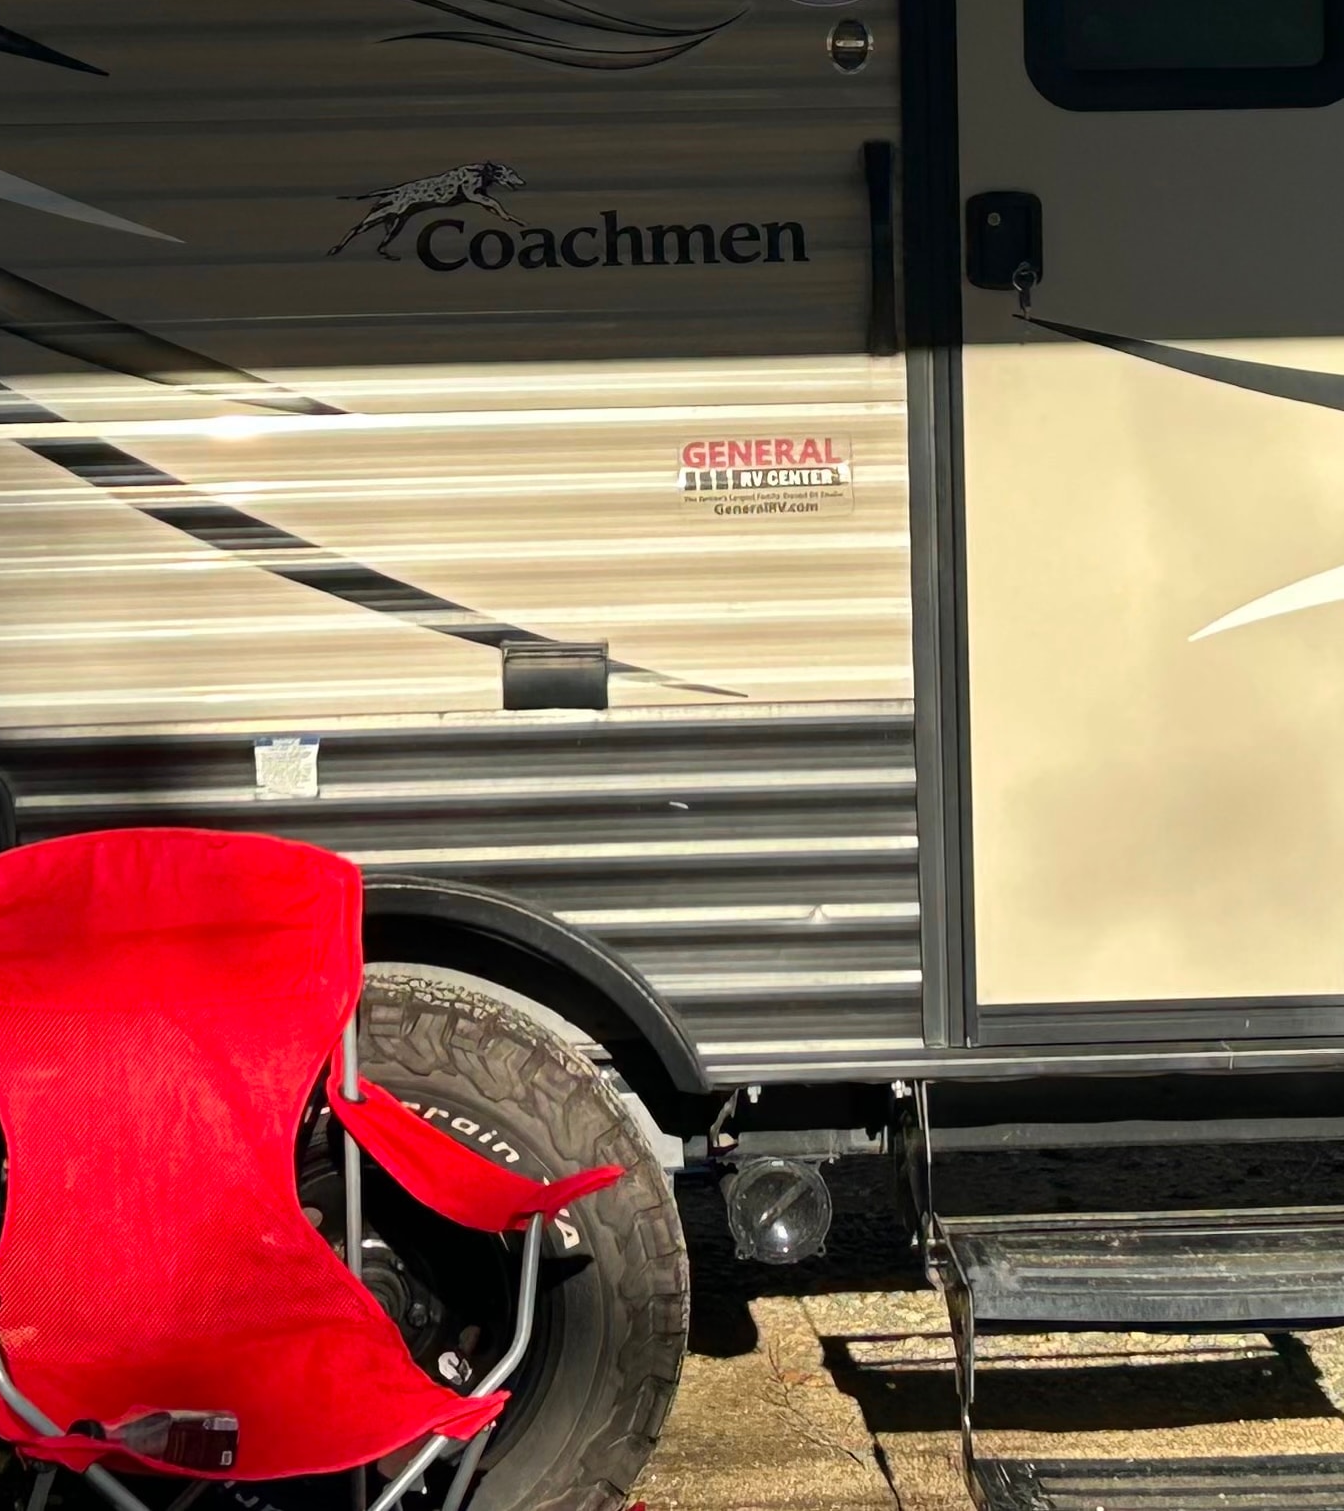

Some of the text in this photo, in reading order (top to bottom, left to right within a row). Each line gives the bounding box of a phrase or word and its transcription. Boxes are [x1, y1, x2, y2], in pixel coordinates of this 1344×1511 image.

[416, 210, 810, 271] Coachmen
[682, 438, 842, 468] GENERAL
[740, 469, 833, 488] RV CENTER
[714, 502, 818, 515] GeneralRV.com
